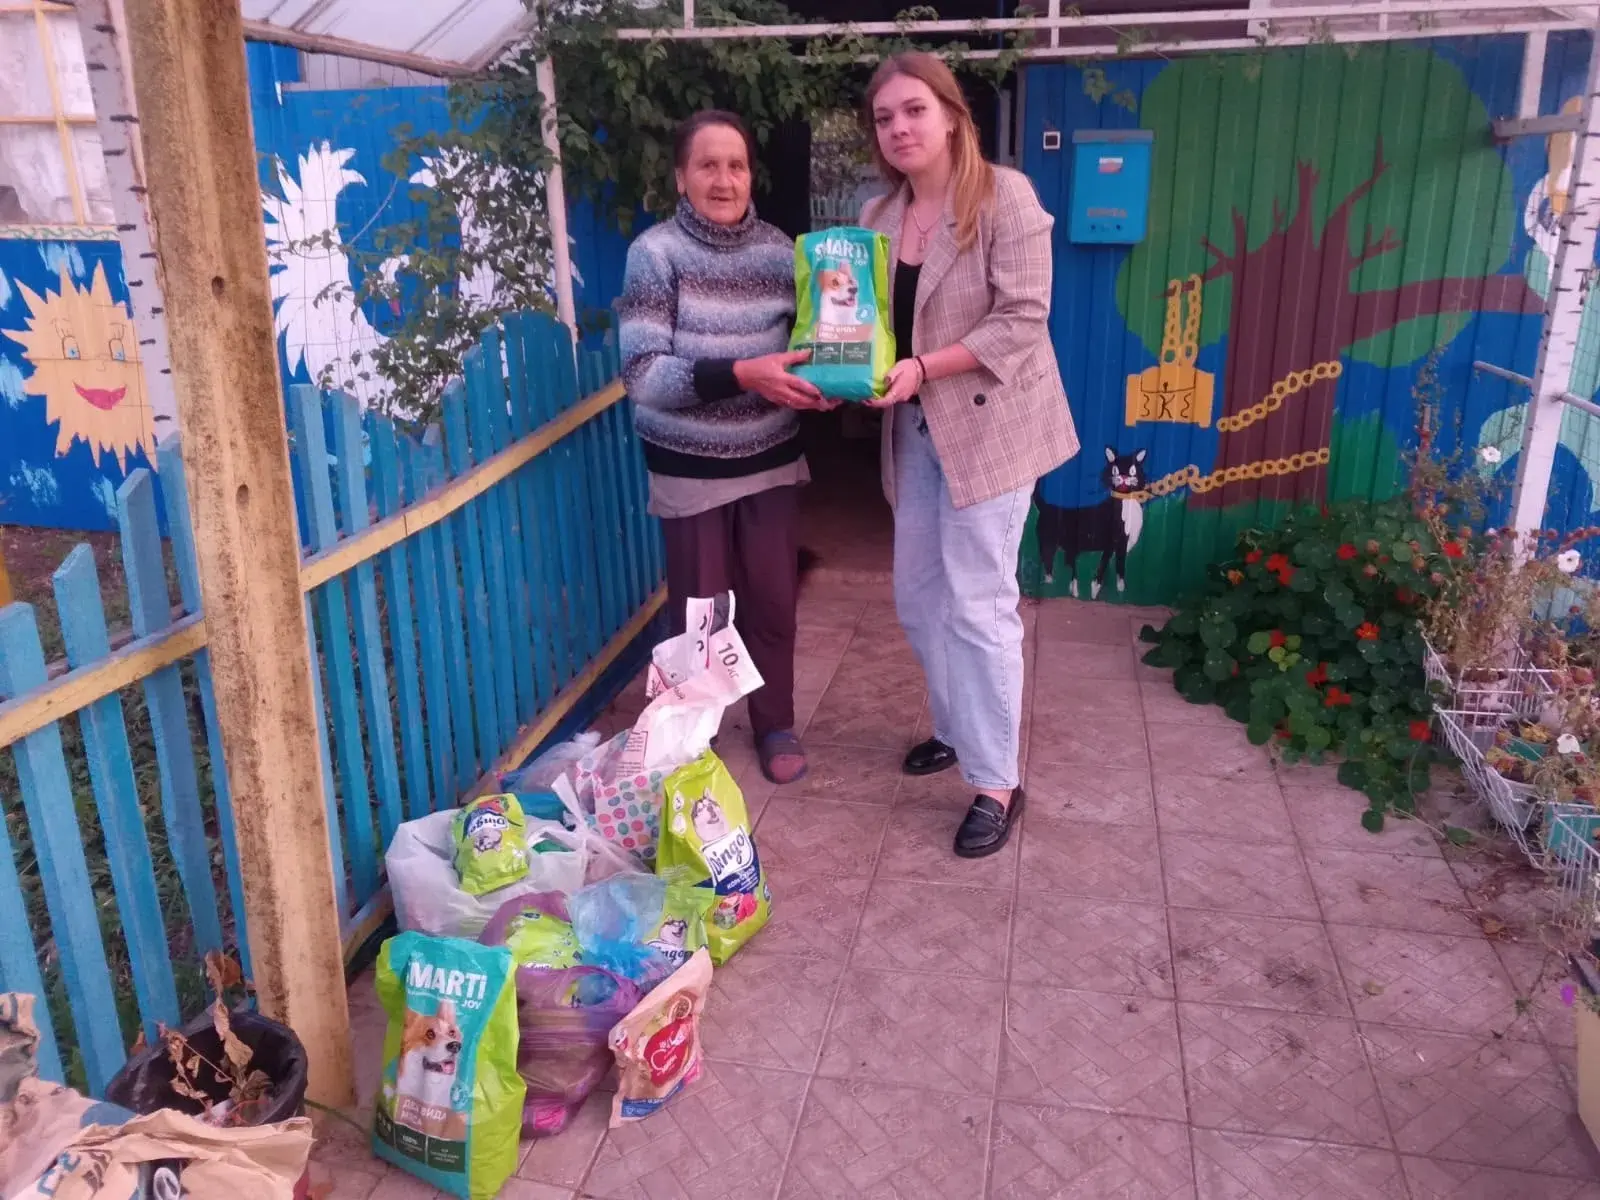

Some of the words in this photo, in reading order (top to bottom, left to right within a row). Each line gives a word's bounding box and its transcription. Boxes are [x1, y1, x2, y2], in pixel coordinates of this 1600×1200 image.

[718, 642, 739, 666] 10
[709, 833, 745, 875] Dingo
[461, 999, 482, 1011] JOY
[421, 1107, 447, 1122] ВИДА
